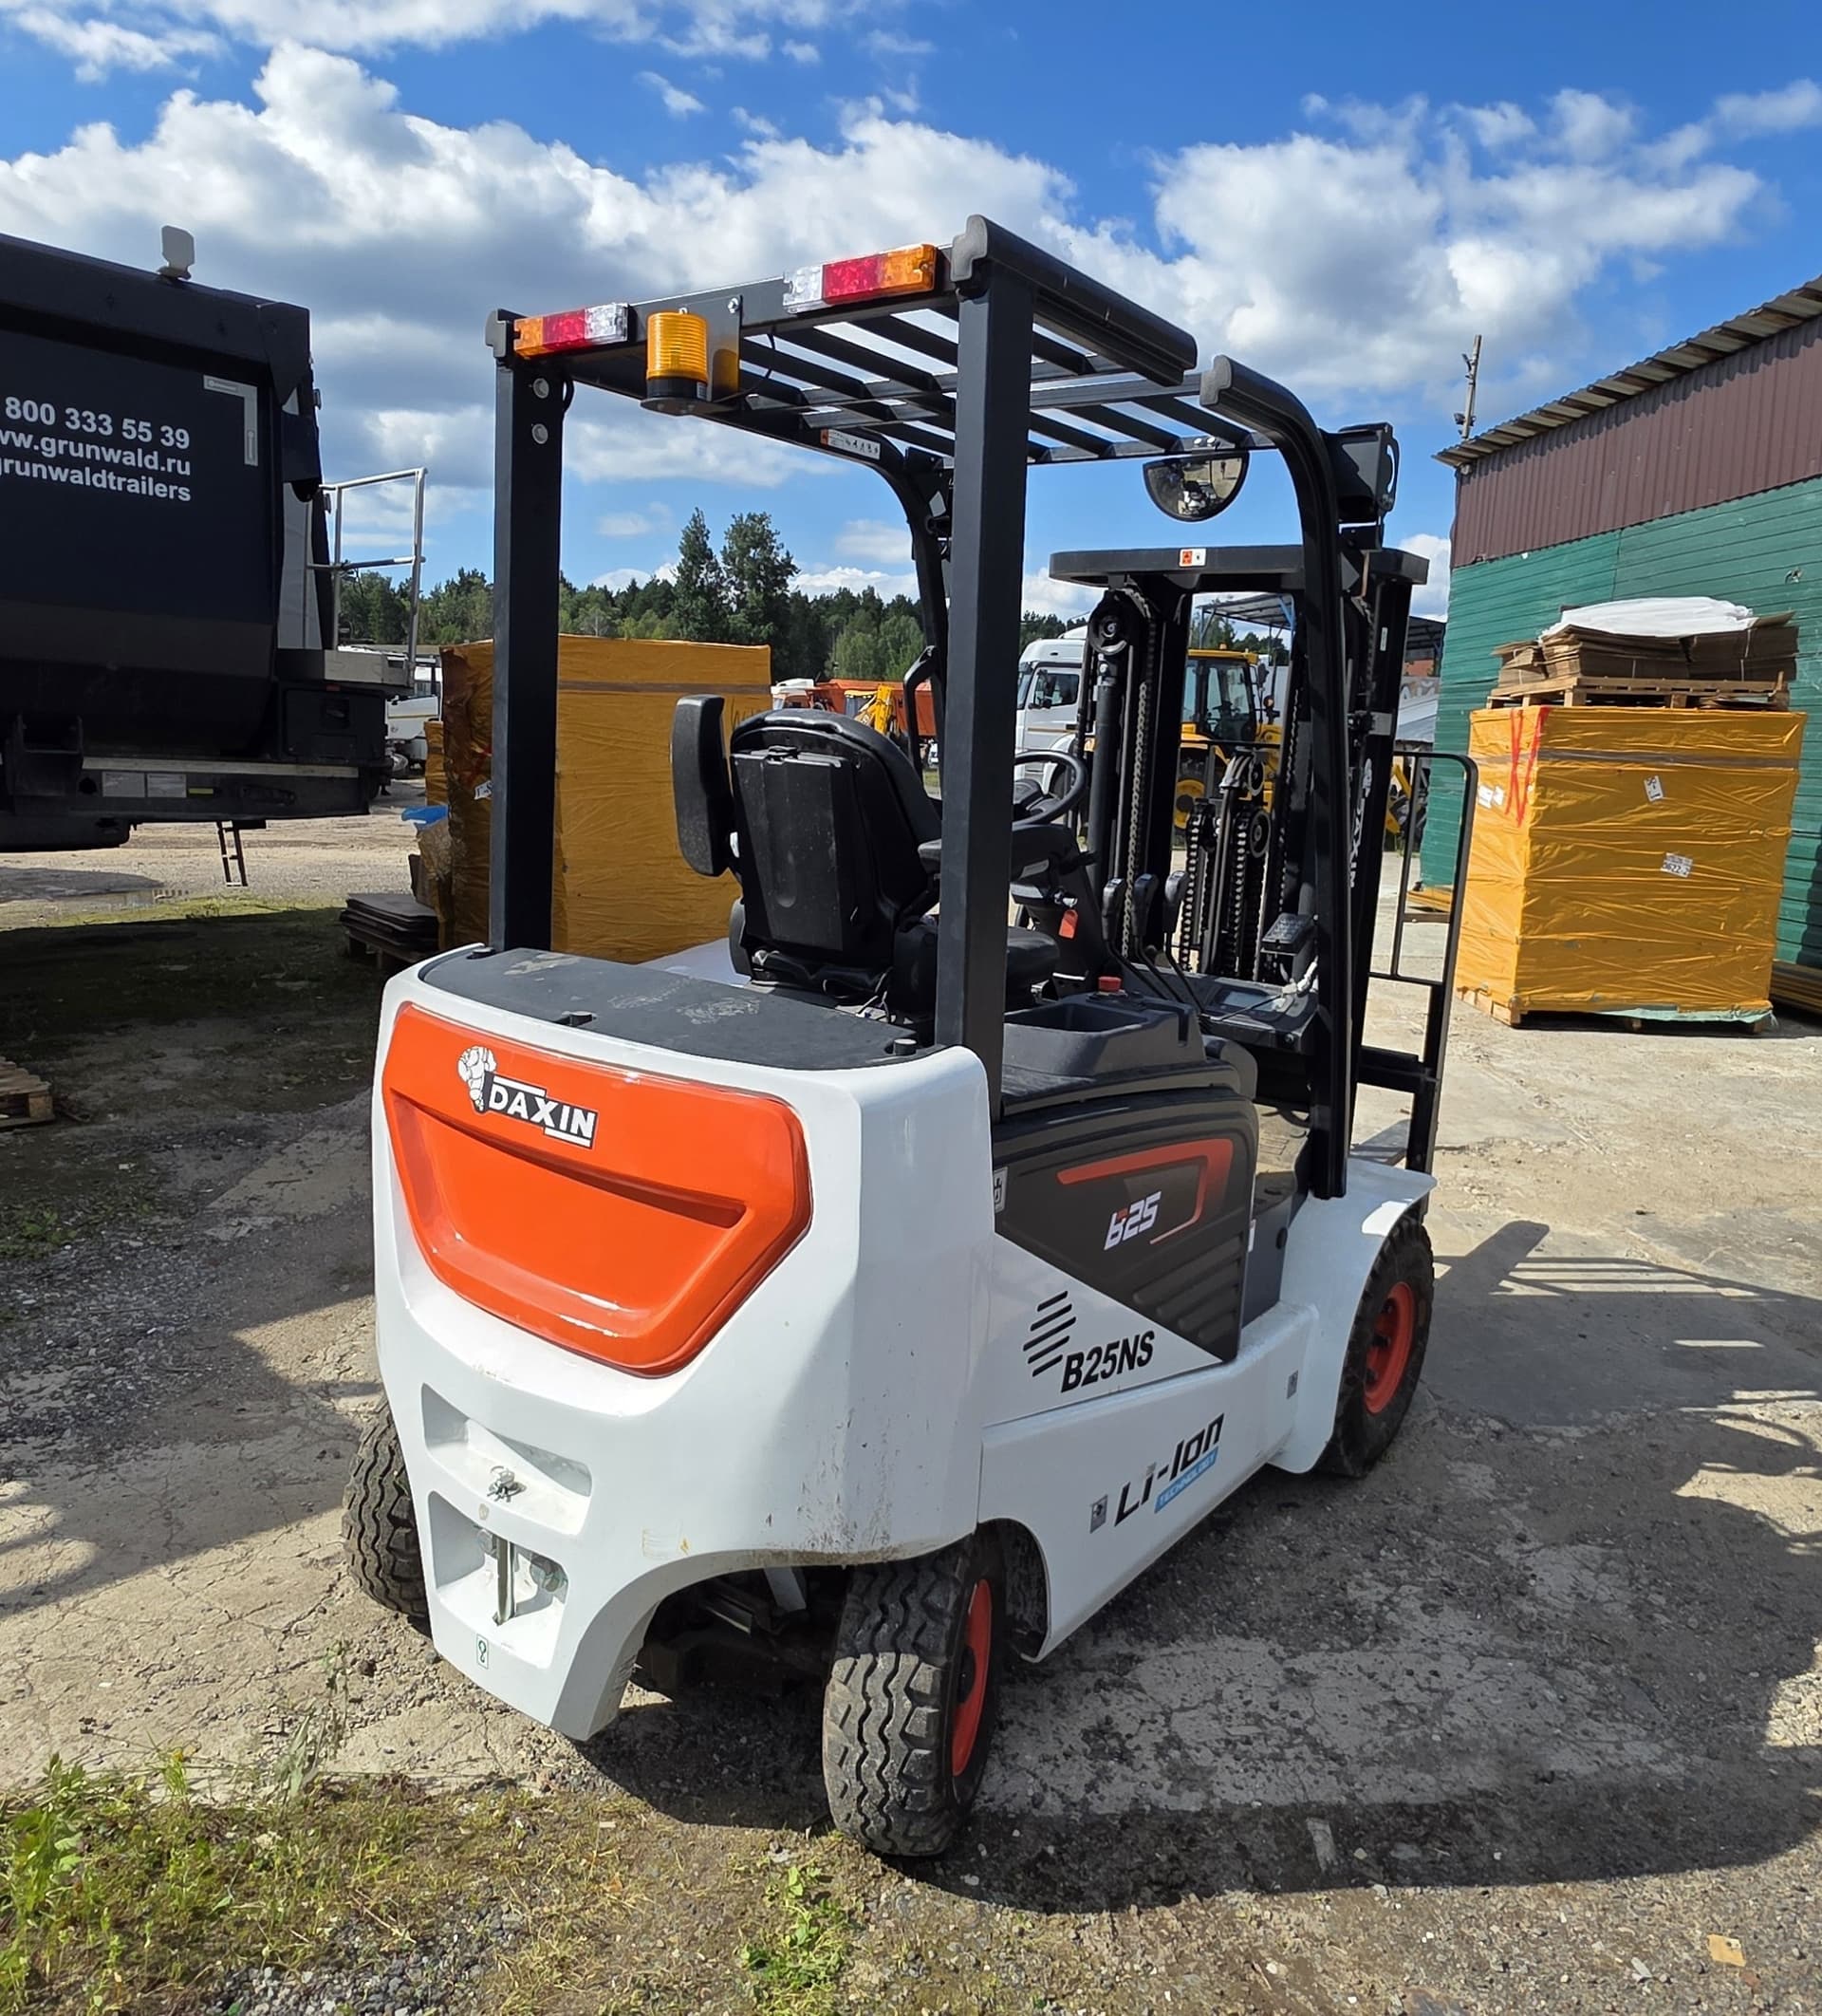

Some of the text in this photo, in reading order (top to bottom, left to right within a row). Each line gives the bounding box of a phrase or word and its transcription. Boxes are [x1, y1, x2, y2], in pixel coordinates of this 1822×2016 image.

[5, 396, 190, 450] 800 333 55 39
[0, 457, 191, 502] runwaldtrailers
[489, 1083, 596, 1139] DAXIN
[1060, 1330, 1155, 1393] B25NS
